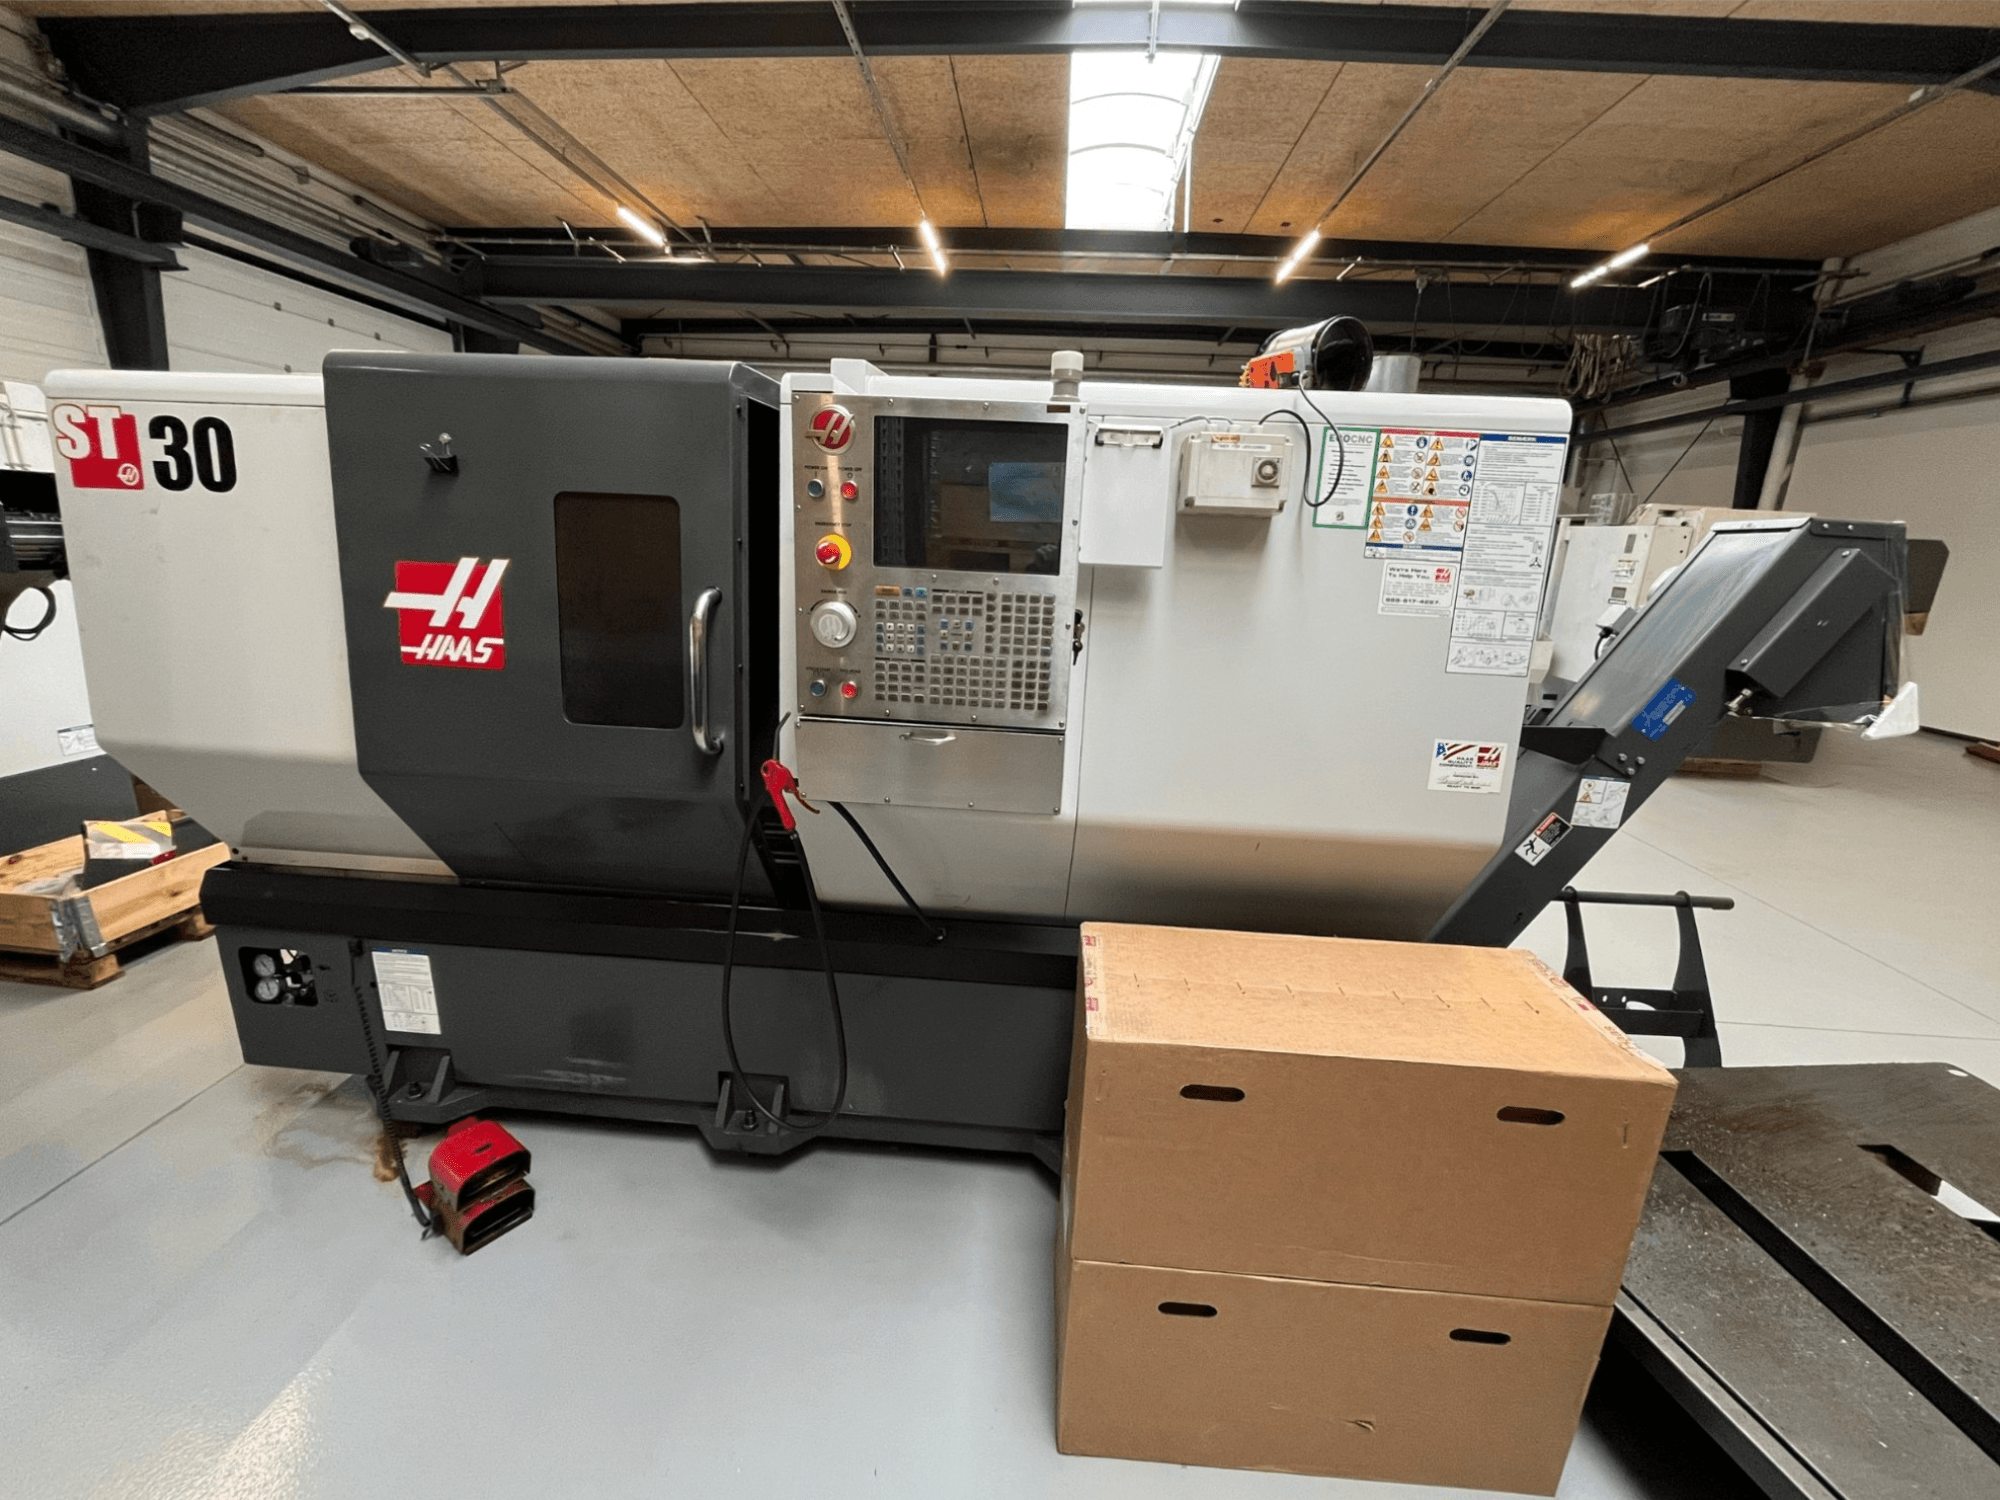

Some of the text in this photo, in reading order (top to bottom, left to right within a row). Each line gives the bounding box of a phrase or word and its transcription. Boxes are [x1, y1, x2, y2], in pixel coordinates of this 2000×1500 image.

[52, 403, 237, 493] ST 30
[400, 633, 504, 664] HAAS
